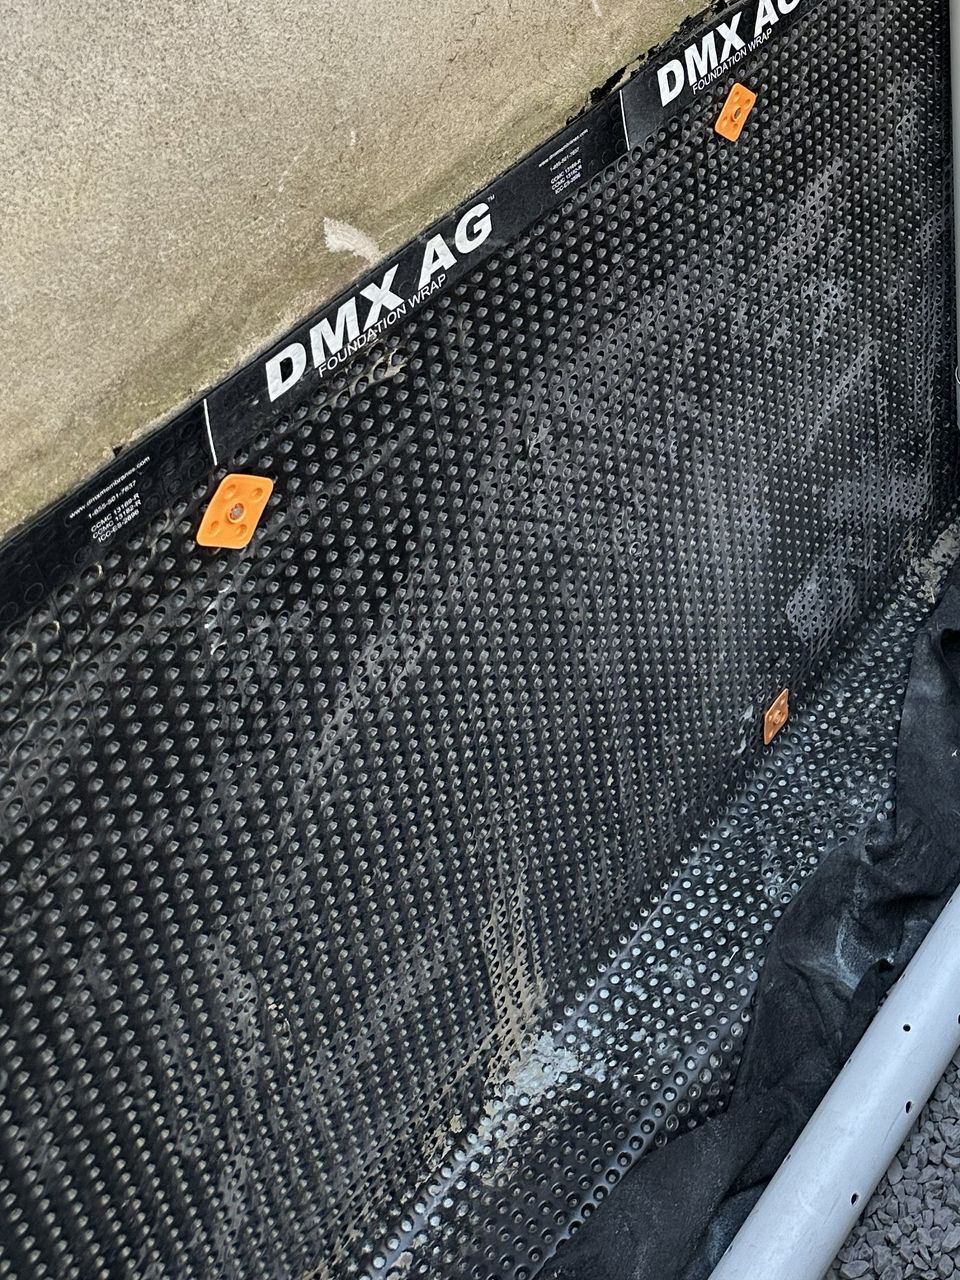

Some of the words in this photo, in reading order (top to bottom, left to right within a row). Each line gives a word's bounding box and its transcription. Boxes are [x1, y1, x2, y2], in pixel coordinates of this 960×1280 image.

[656, 10, 746, 107] DMX
[692, 44, 748, 95] FOUNDATION
[748, 27, 773, 53] WRAP
[265, 263, 405, 403] DMX
[417, 202, 494, 291] AG
[317, 303, 407, 378] FOUNDATION
[408, 273, 447, 308] WRAP
[90, 513, 113, 533] CCMC
[92, 520, 114, 540] CCMC
